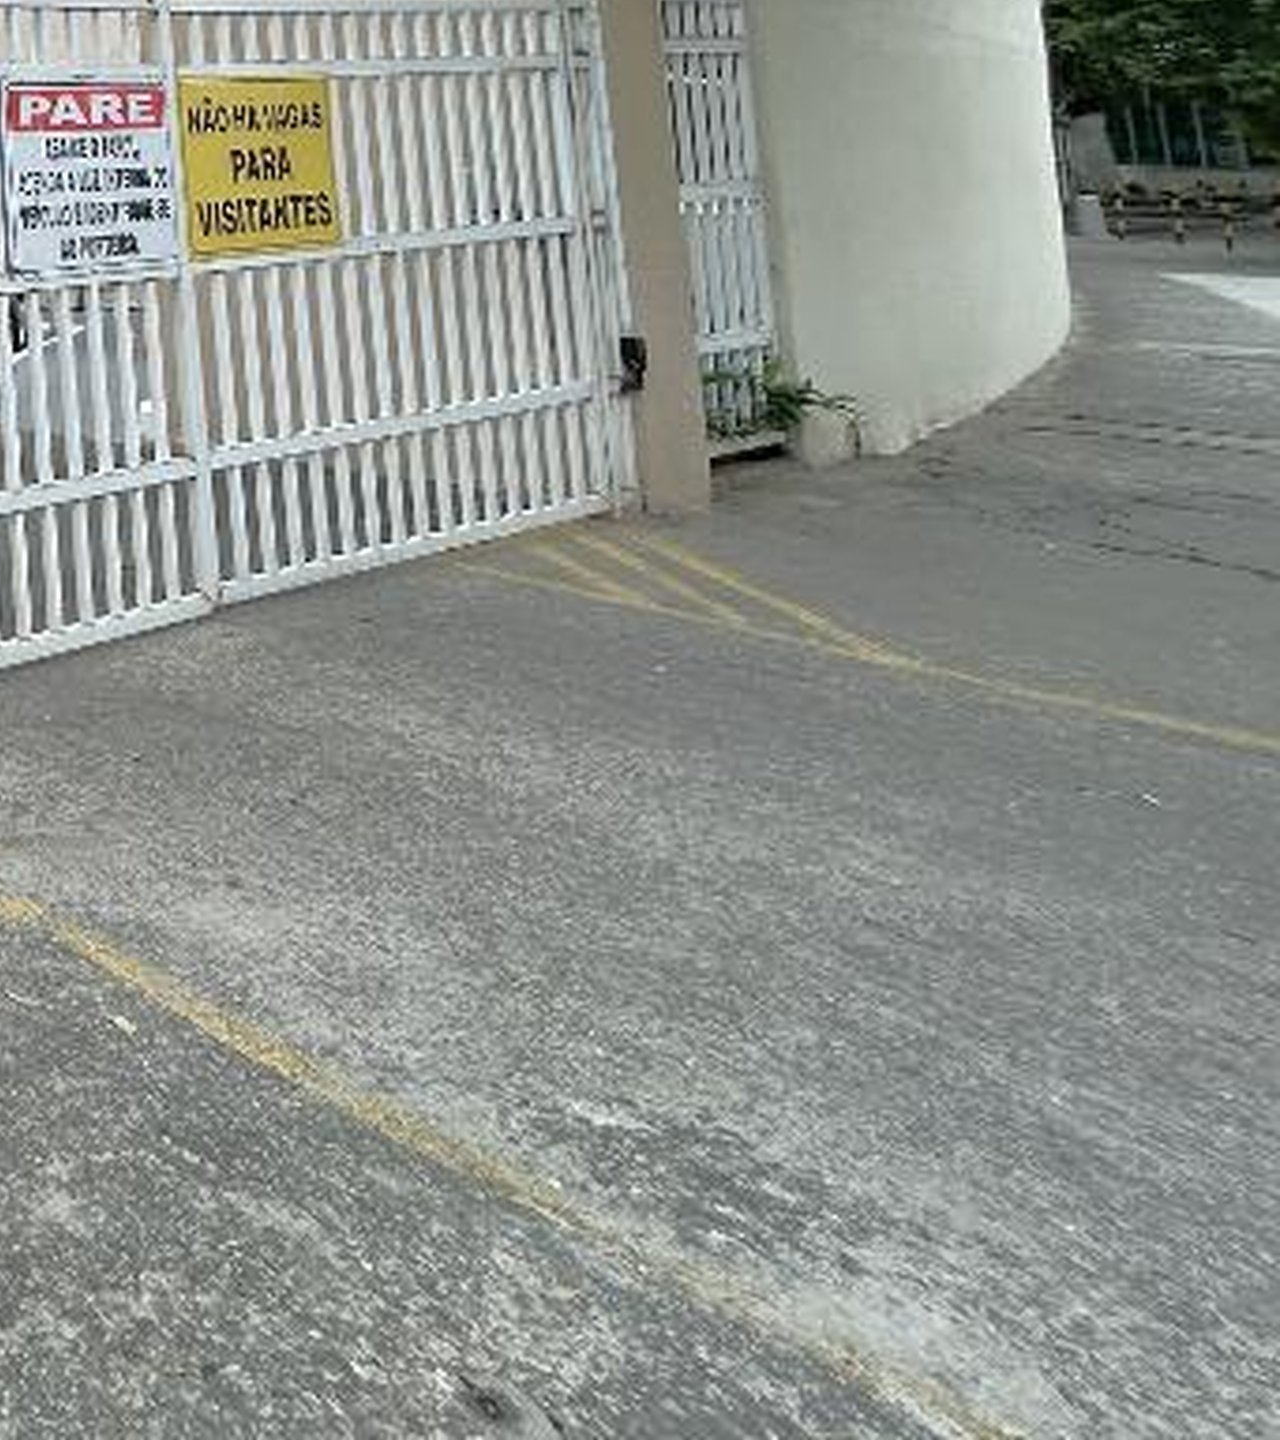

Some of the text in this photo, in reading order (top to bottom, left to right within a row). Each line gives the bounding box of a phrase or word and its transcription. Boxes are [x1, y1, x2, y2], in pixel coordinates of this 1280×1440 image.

[17, 92, 158, 127] PARE
[229, 146, 292, 183] PARA
[196, 190, 333, 237] VISITANTES
